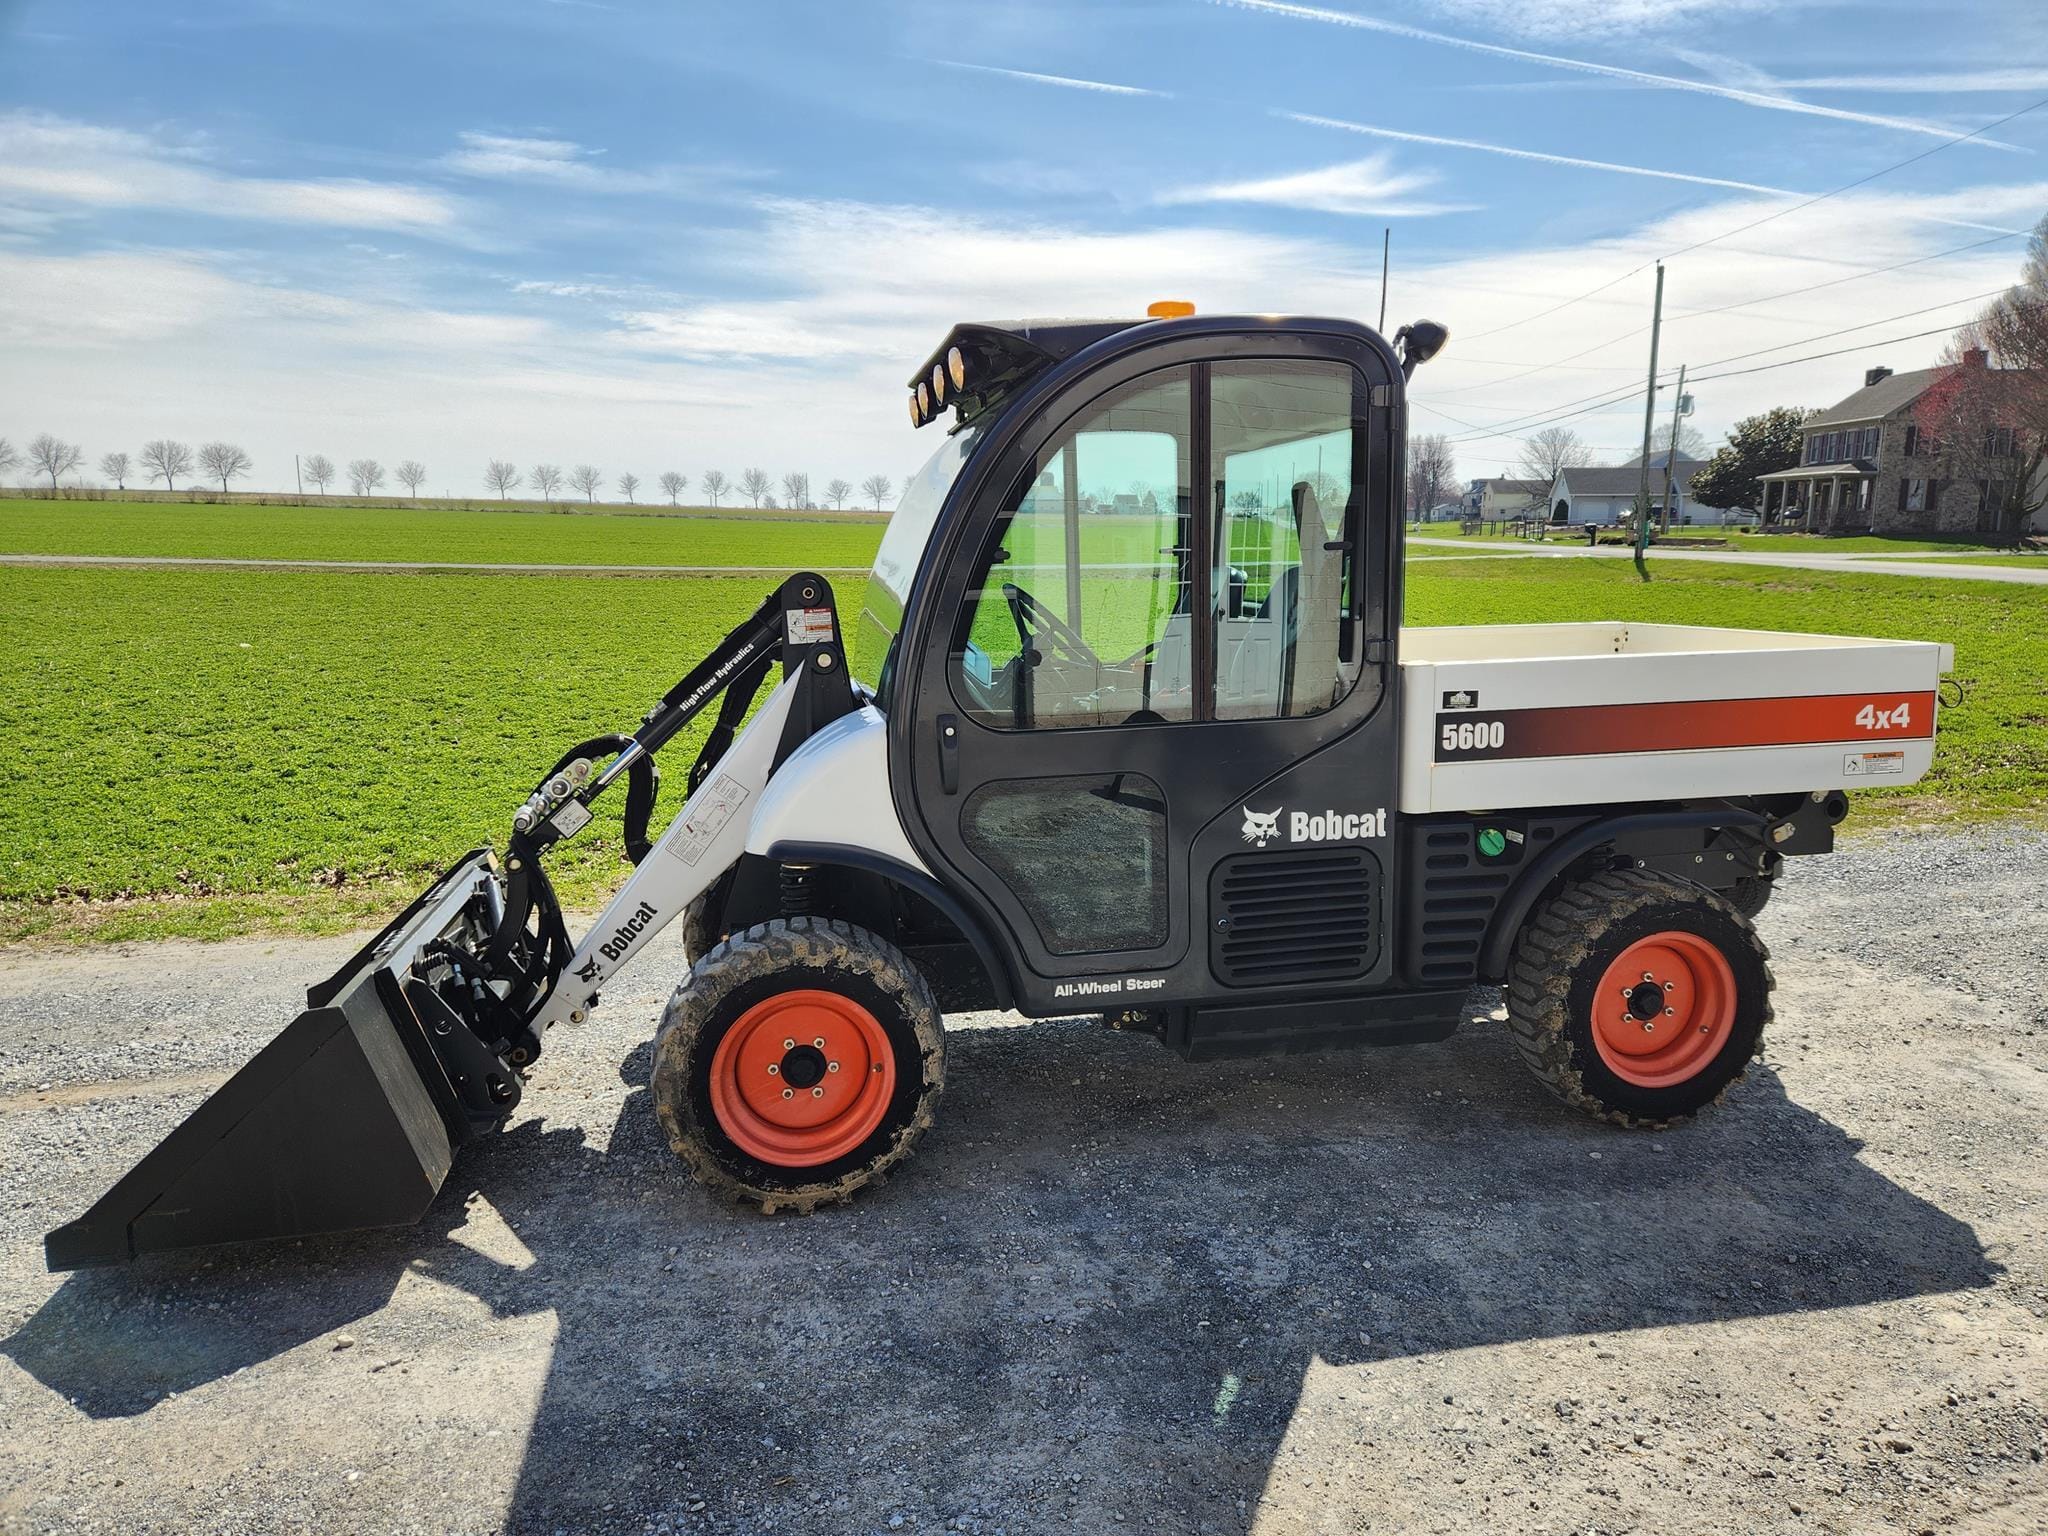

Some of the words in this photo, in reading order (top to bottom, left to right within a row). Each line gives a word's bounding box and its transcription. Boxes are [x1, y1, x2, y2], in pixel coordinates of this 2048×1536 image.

[680, 694, 699, 711] High
[696, 676, 717, 695] Flow
[715, 643, 754, 678] Hydraulics
[1855, 703, 1910, 729] 4x4
[1442, 721, 1504, 750] 5600
[1290, 808, 1386, 842] Bobcat
[599, 901, 658, 961] Bobcat
[1054, 980, 1122, 997] All-Wheel
[1126, 979, 1165, 991] Steer
